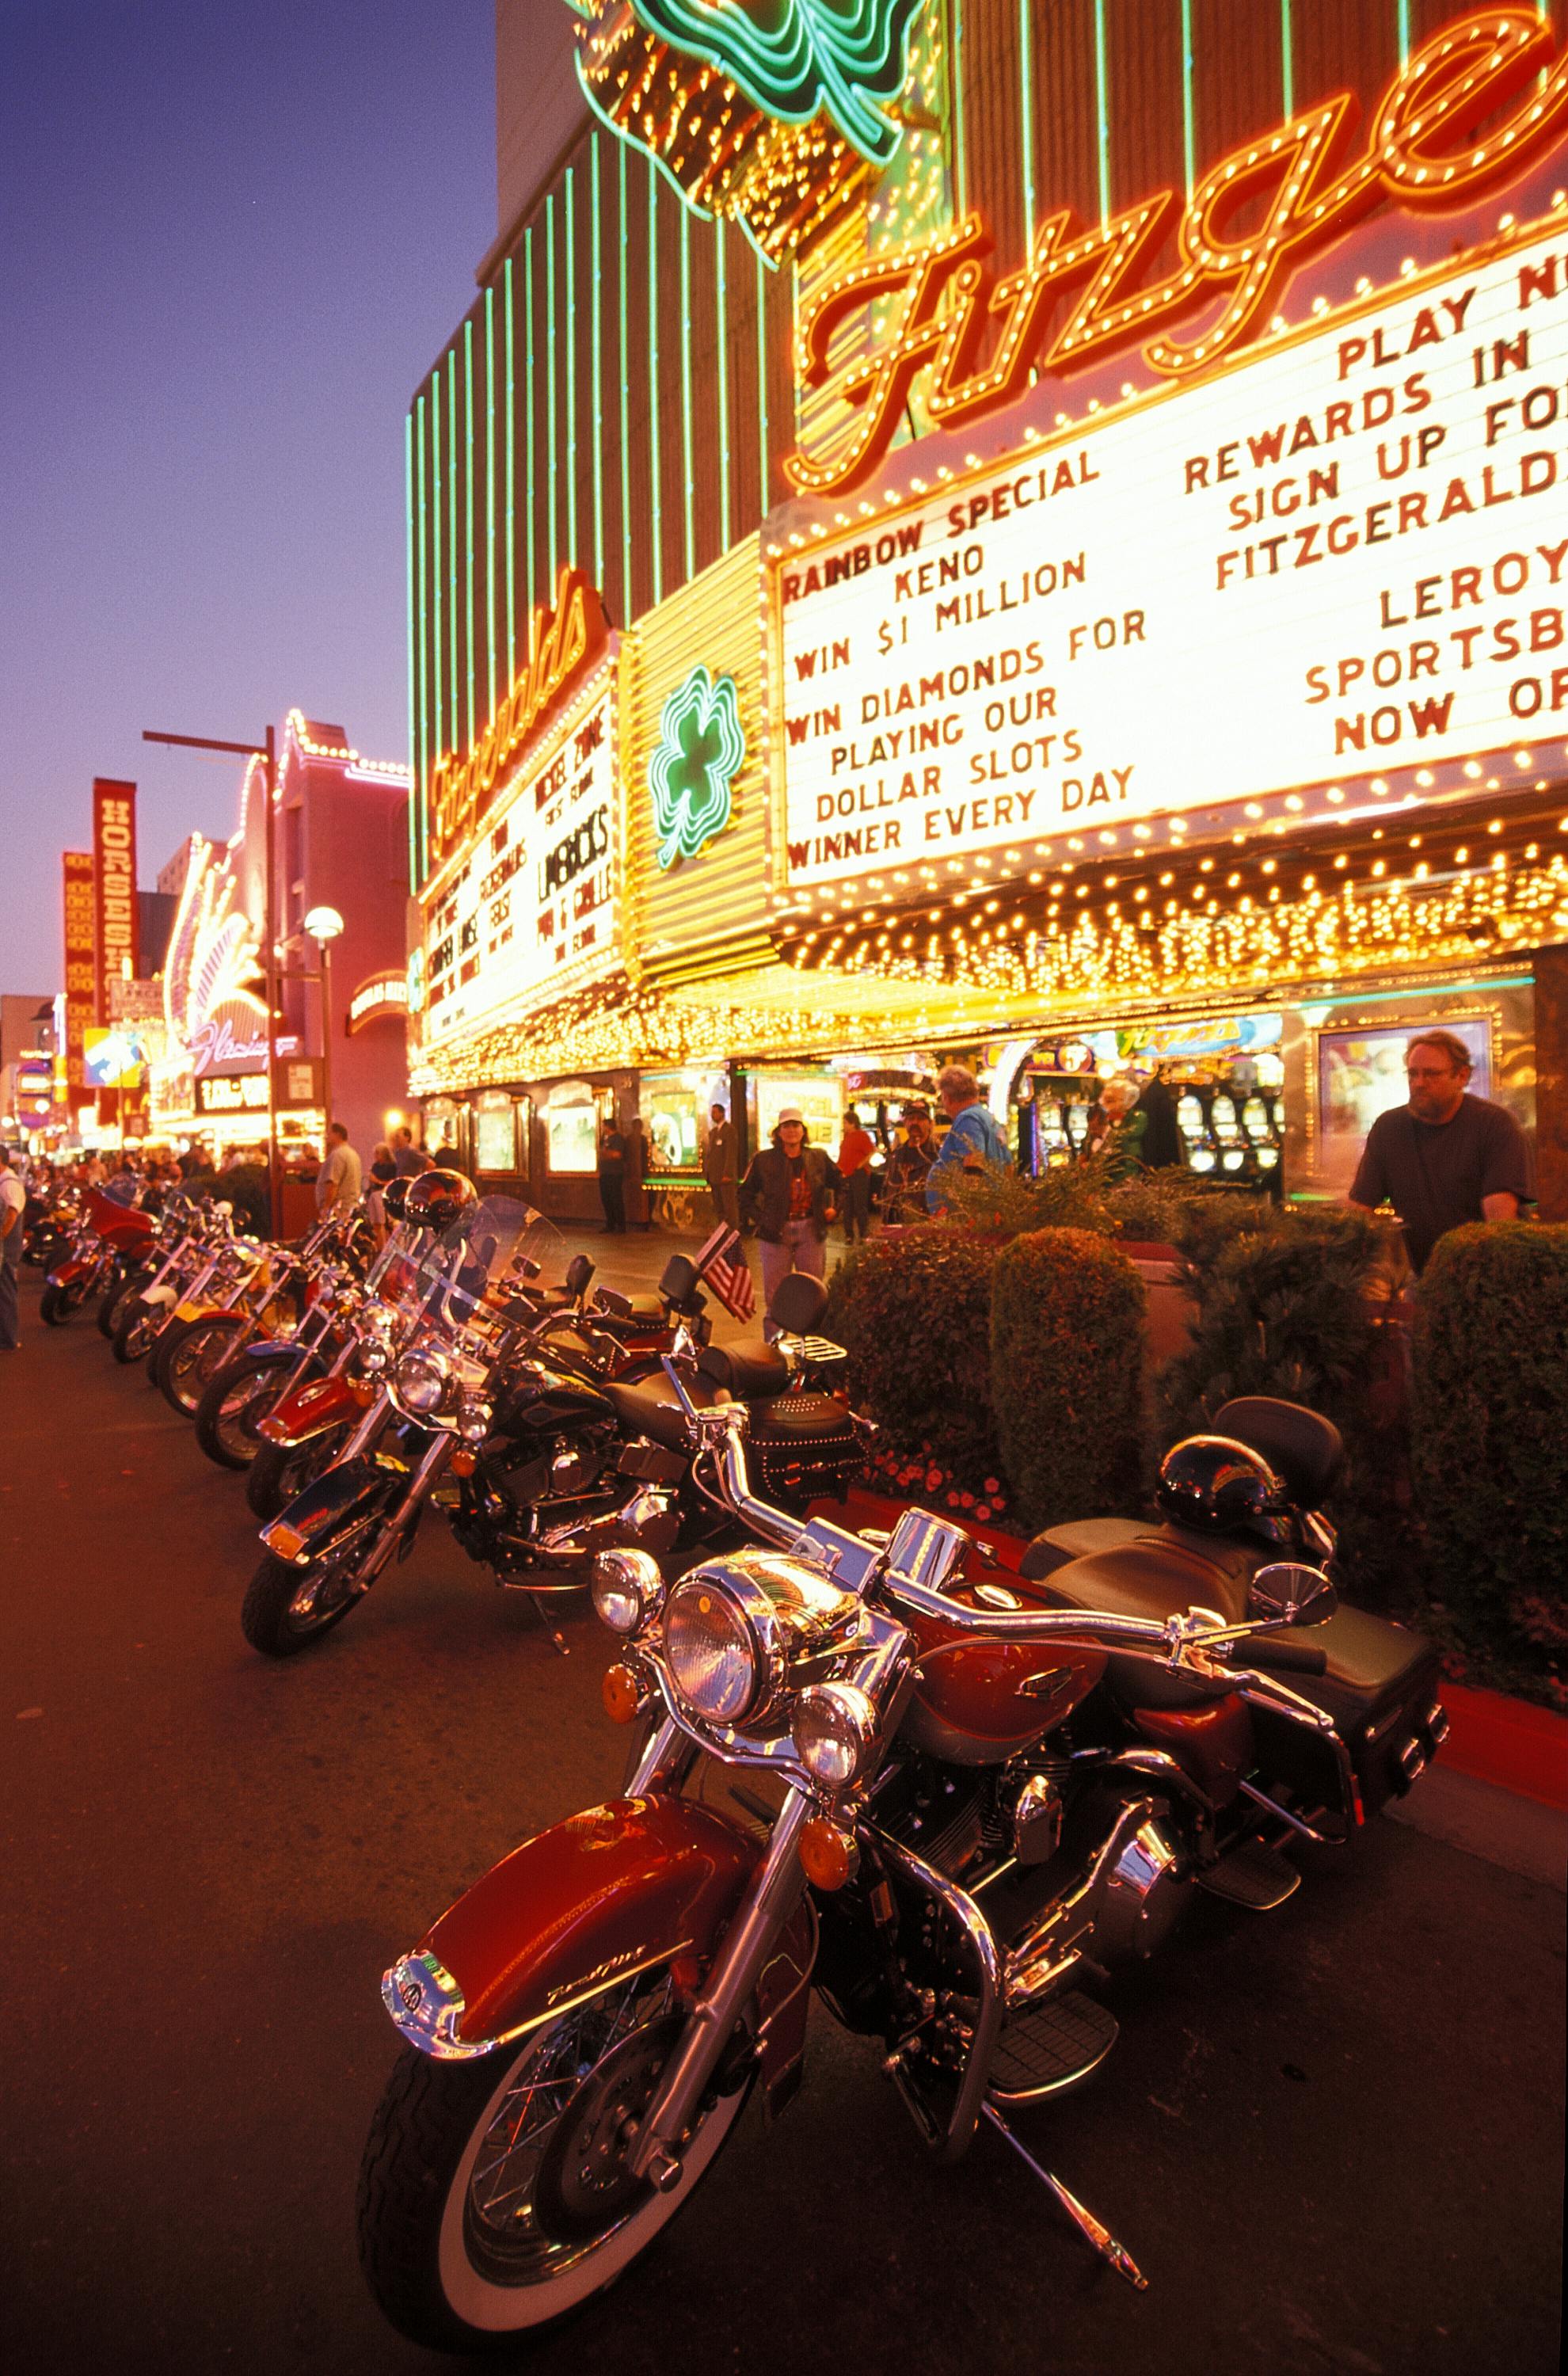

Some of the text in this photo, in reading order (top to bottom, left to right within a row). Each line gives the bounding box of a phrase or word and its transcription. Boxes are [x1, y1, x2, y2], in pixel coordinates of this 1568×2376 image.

[1338, 286, 1477, 381] PLAY
[1184, 329, 1529, 494] REWARDS IN
[1229, 385, 1568, 531] SIGN UP FO
[782, 451, 1100, 607] RAINBOW SPECIAL
[894, 544, 984, 603] KENO
[795, 552, 1087, 681] WIN $1 MILLION
[786, 609, 1146, 746] WIN DIAMONDS FOR
[1334, 691, 1454, 755] NOW
[816, 729, 1082, 822] DOLLAR SLOTS
[831, 687, 1057, 775] PLAYING OUR
[788, 765, 1135, 870] WINNER EVERY DAY
